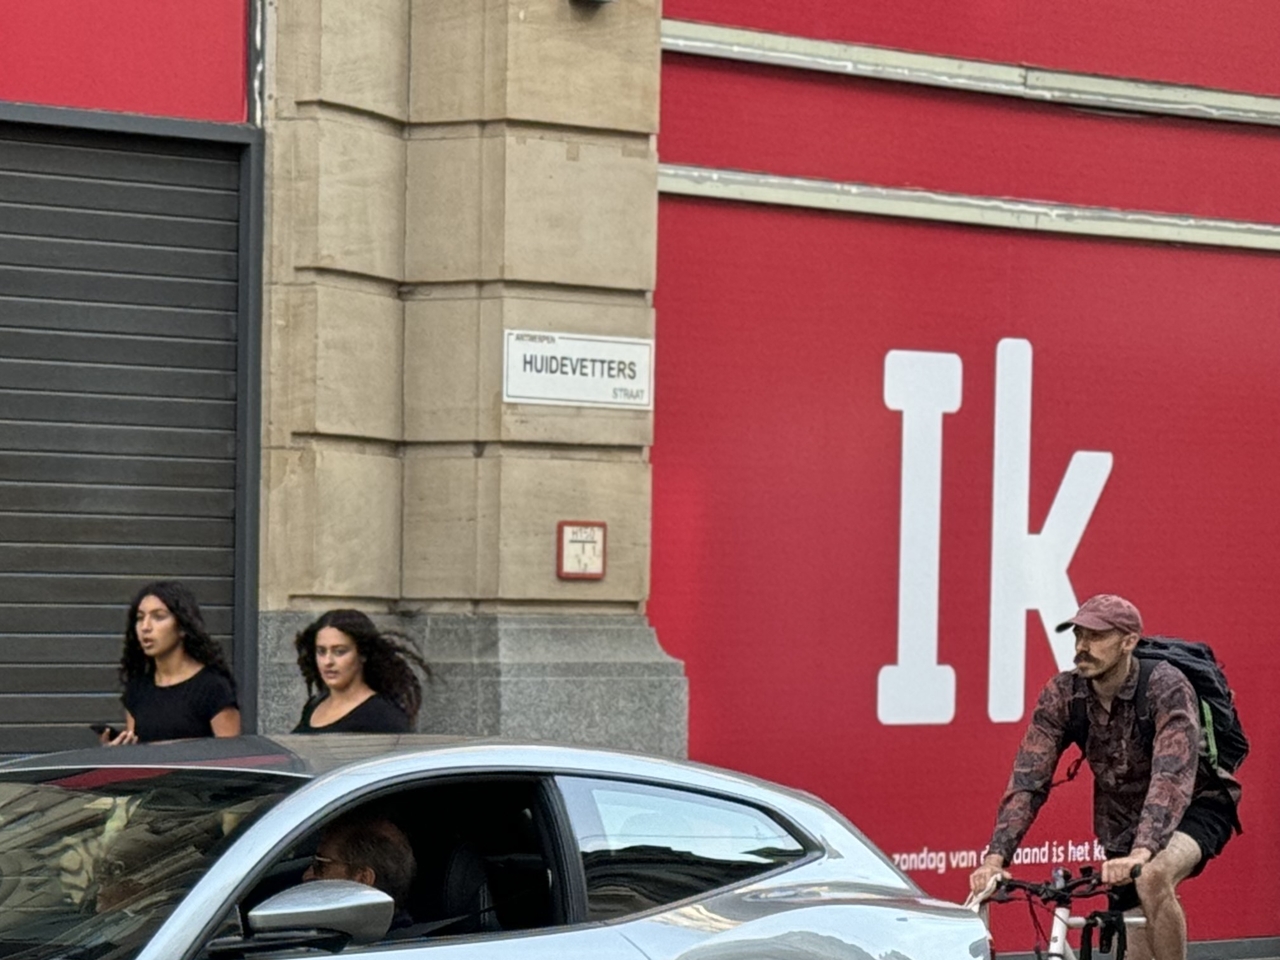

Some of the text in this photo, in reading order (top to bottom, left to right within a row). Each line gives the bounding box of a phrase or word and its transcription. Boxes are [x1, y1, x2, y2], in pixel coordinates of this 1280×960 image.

[523, 353, 637, 380] HUIDEVETTERS
[612, 387, 645, 400] STRAAT
[877, 337, 1114, 725] Ik
[892, 846, 946, 874] zondag
[949, 850, 977, 868] van
[1013, 841, 1049, 864] aand
[1052, 841, 1065, 863] is
[1068, 840, 1090, 862] het
